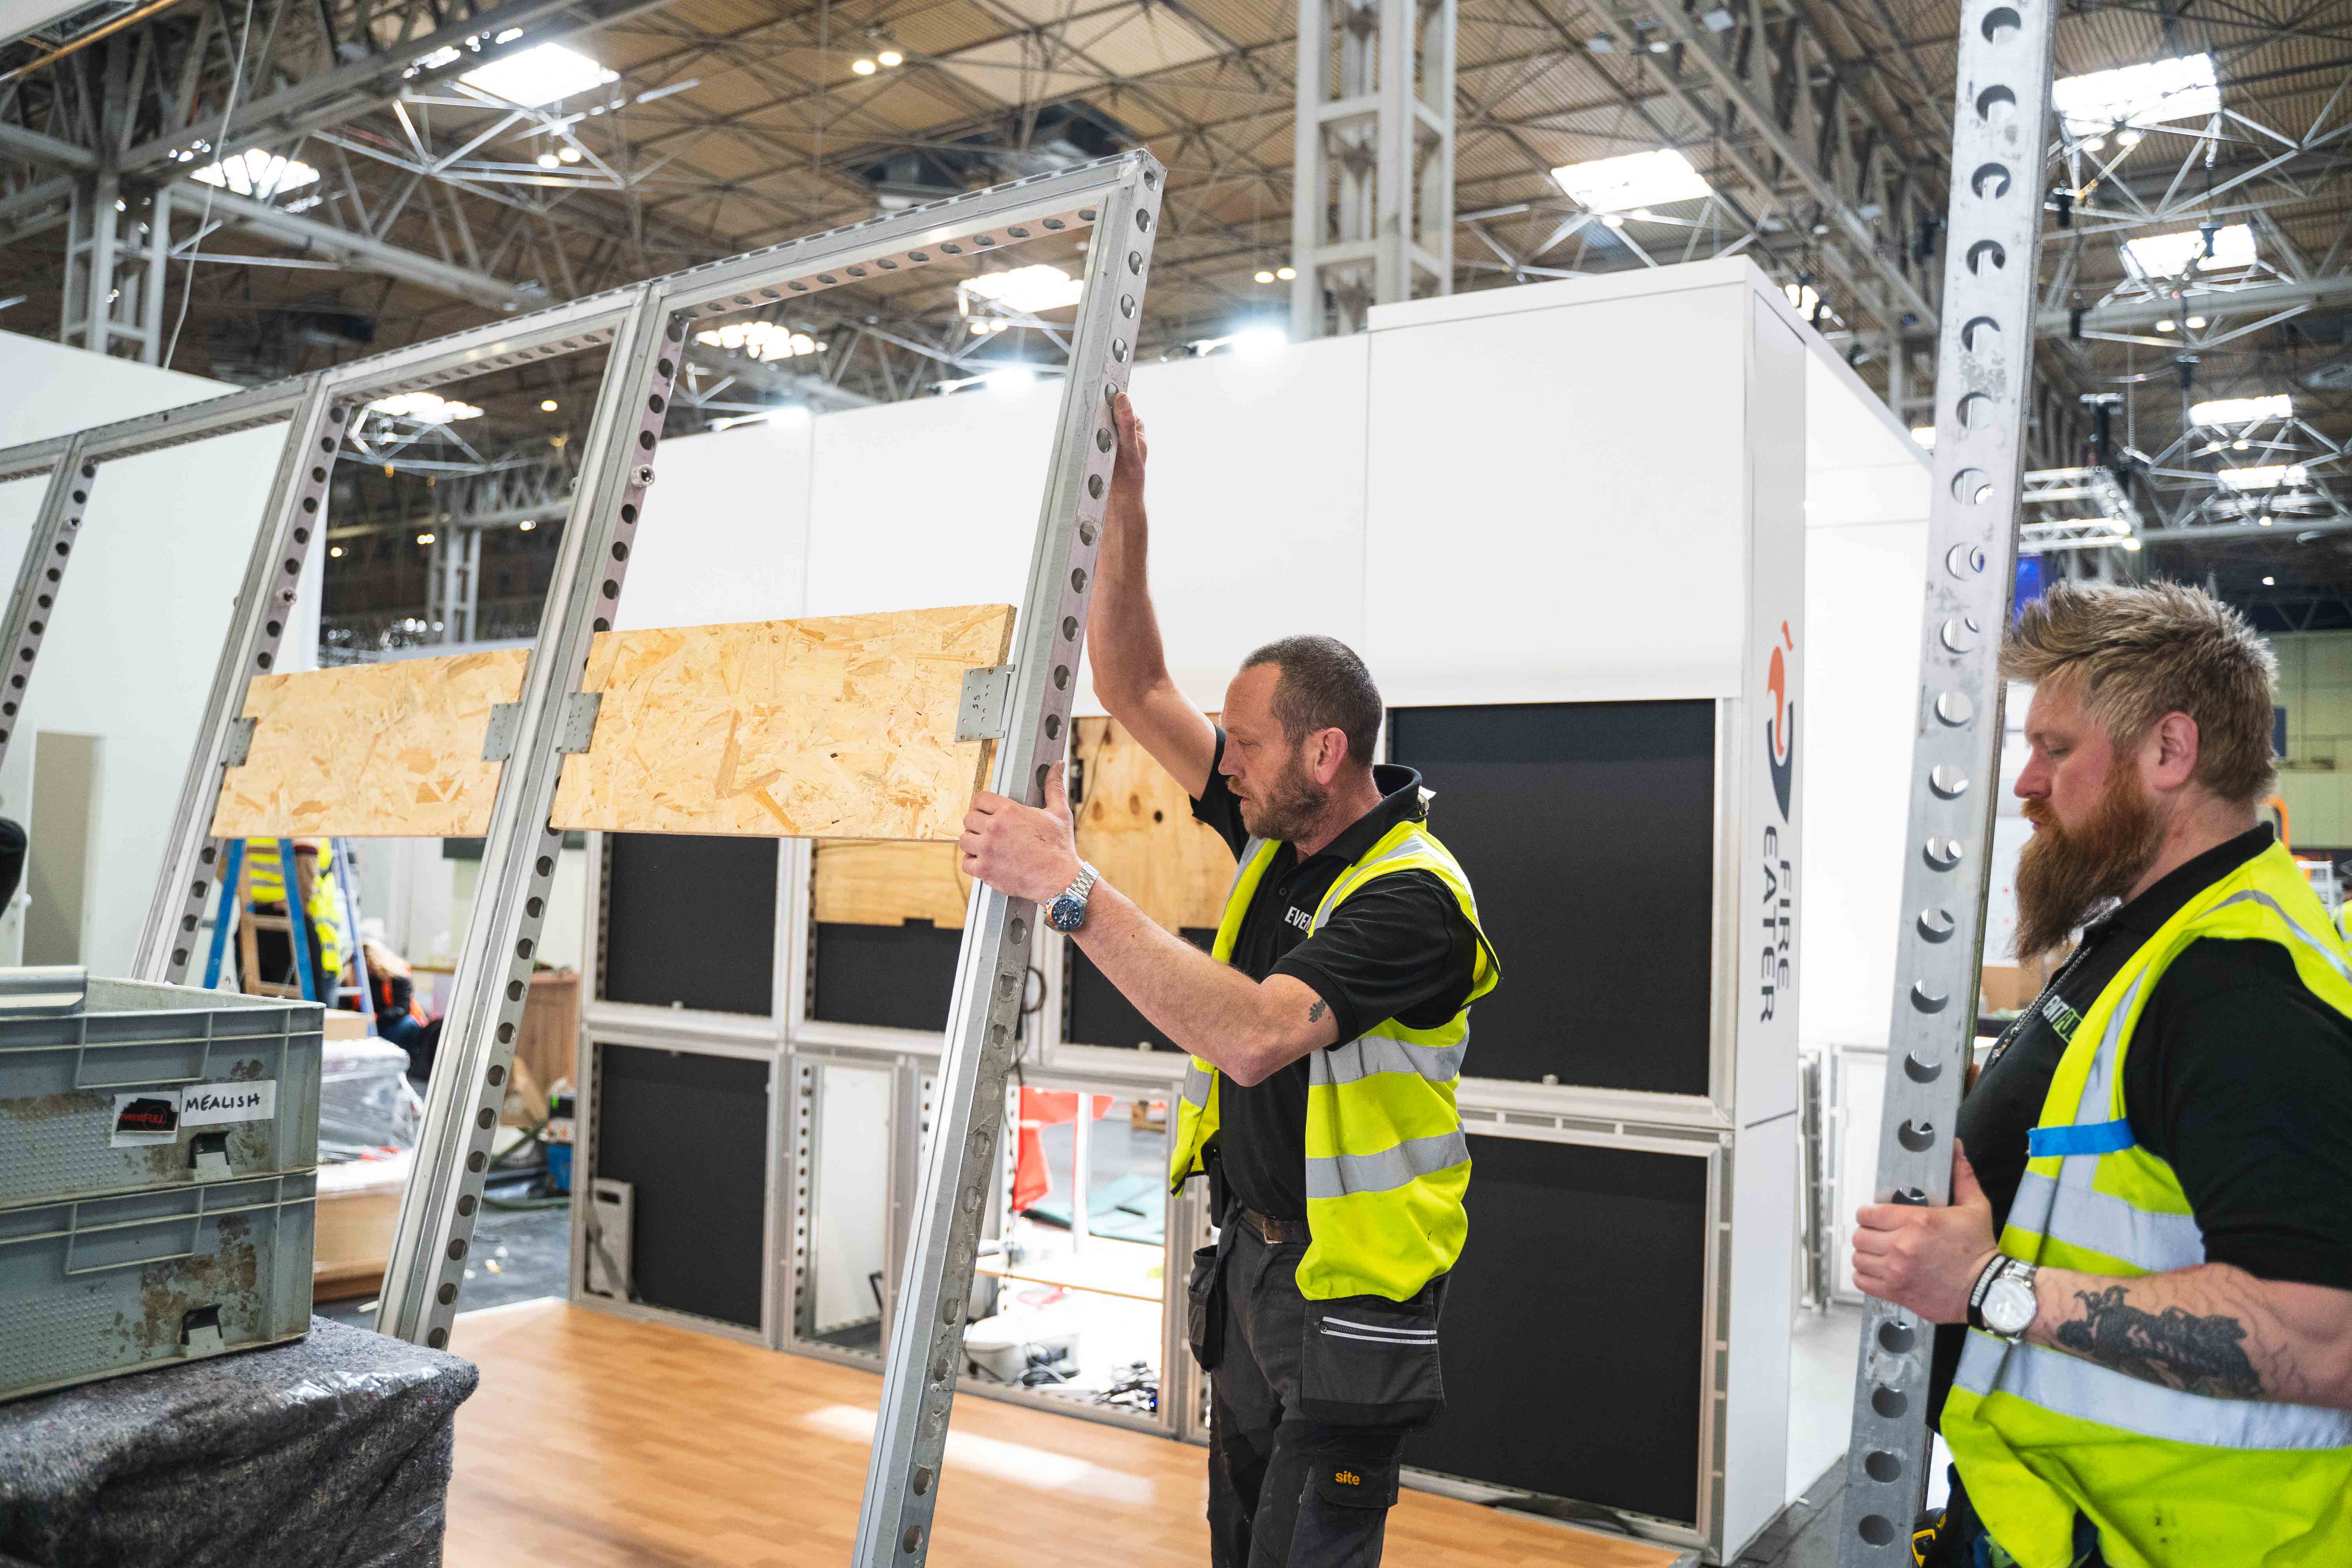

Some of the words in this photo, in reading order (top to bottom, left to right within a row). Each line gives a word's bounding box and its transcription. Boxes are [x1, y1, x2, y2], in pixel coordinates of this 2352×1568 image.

[1760, 826, 1777, 1023] EATER
[1777, 860, 1791, 990] FIRE
[185, 1093, 260, 1112] MEALISH
[1336, 1471, 1360, 1485] site
